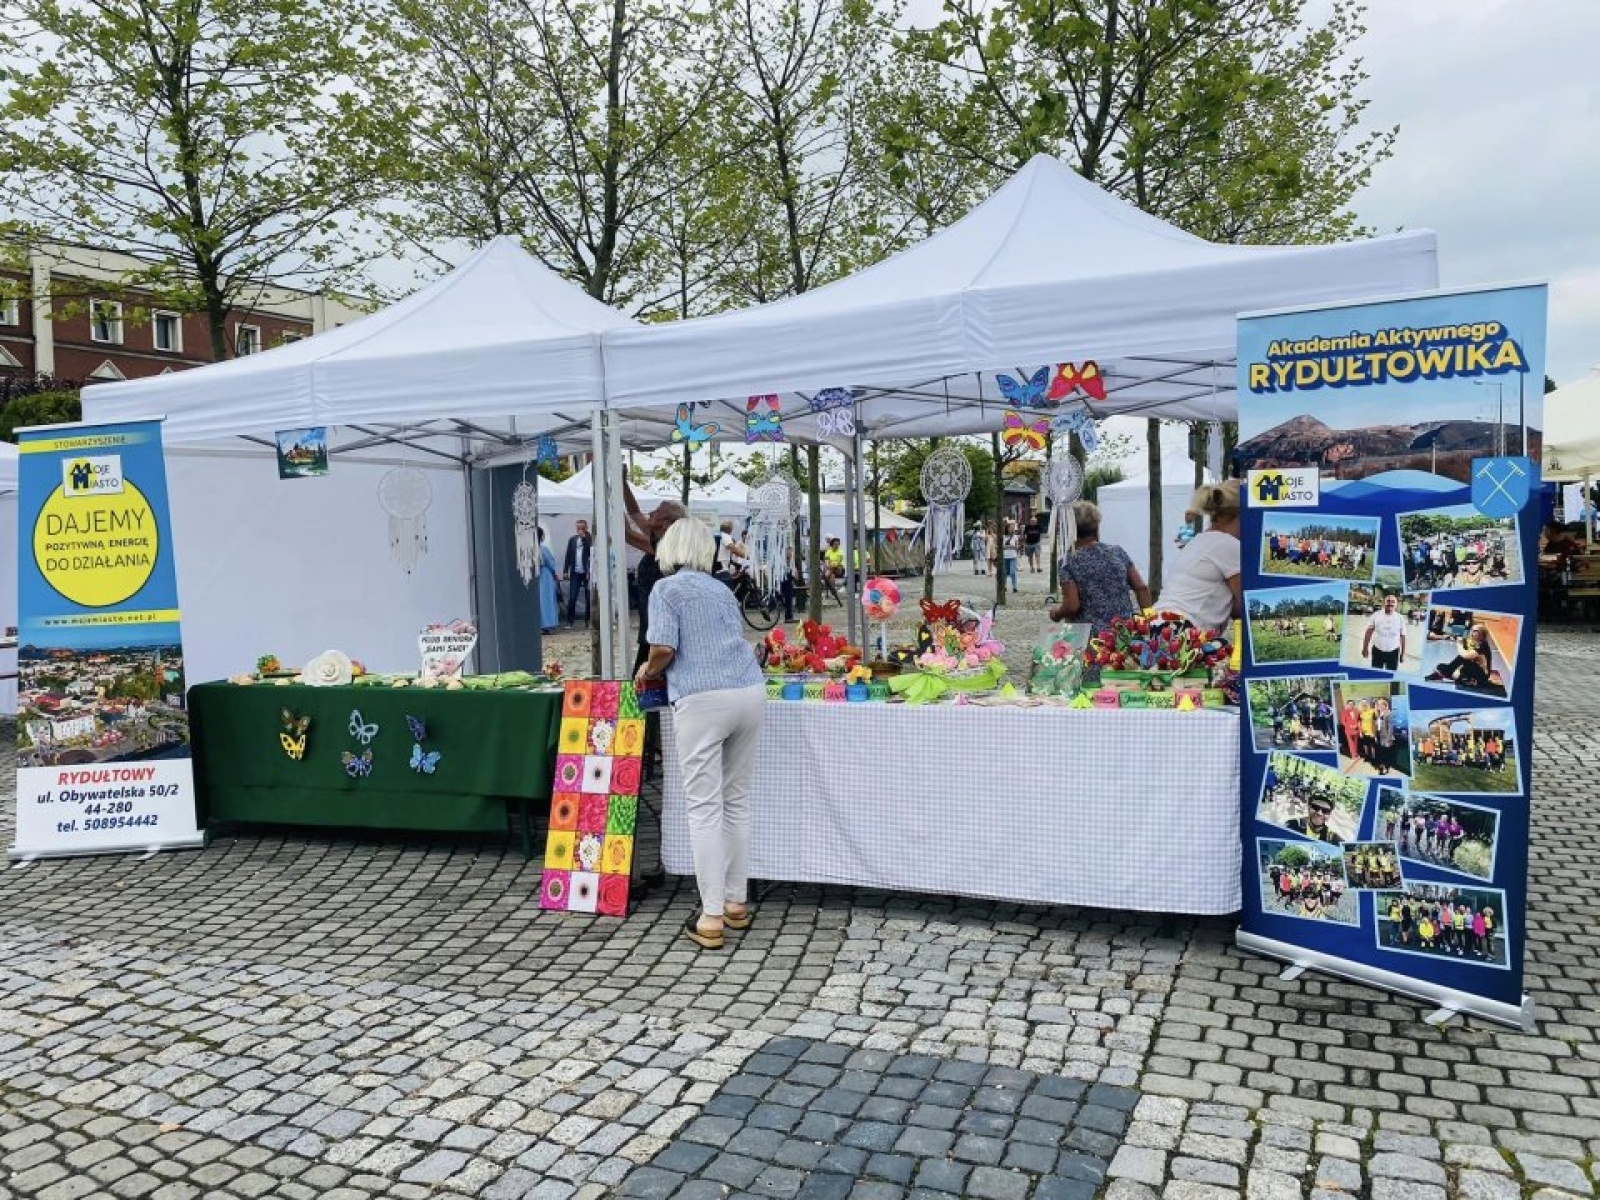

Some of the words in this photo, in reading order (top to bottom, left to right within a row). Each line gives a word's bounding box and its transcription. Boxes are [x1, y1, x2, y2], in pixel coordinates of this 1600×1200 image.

[1268, 331, 1370, 357] Akademia
[1374, 321, 1500, 348] Aktywnego
[1250, 340, 1522, 390] RYDUŁTOWIKA
[54, 436, 125, 448] STOWARZYSZENIE
[46, 508, 146, 536] DAJEMY
[45, 541, 104, 551] POZYTYWNĄ
[109, 537, 149, 548] ENERGIĘ
[46, 557, 70, 572] DO
[73, 553, 151, 570] DZIAŁANIA
[57, 768, 156, 786] RYDUŁTOWY
[37, 793, 54, 804] ul.
[60, 787, 145, 804] Obywatelska
[150, 785, 179, 798] 50/2
[85, 802, 133, 816] 44-280
[57, 820, 79, 833] tel.
[84, 815, 159, 831] 508954442
